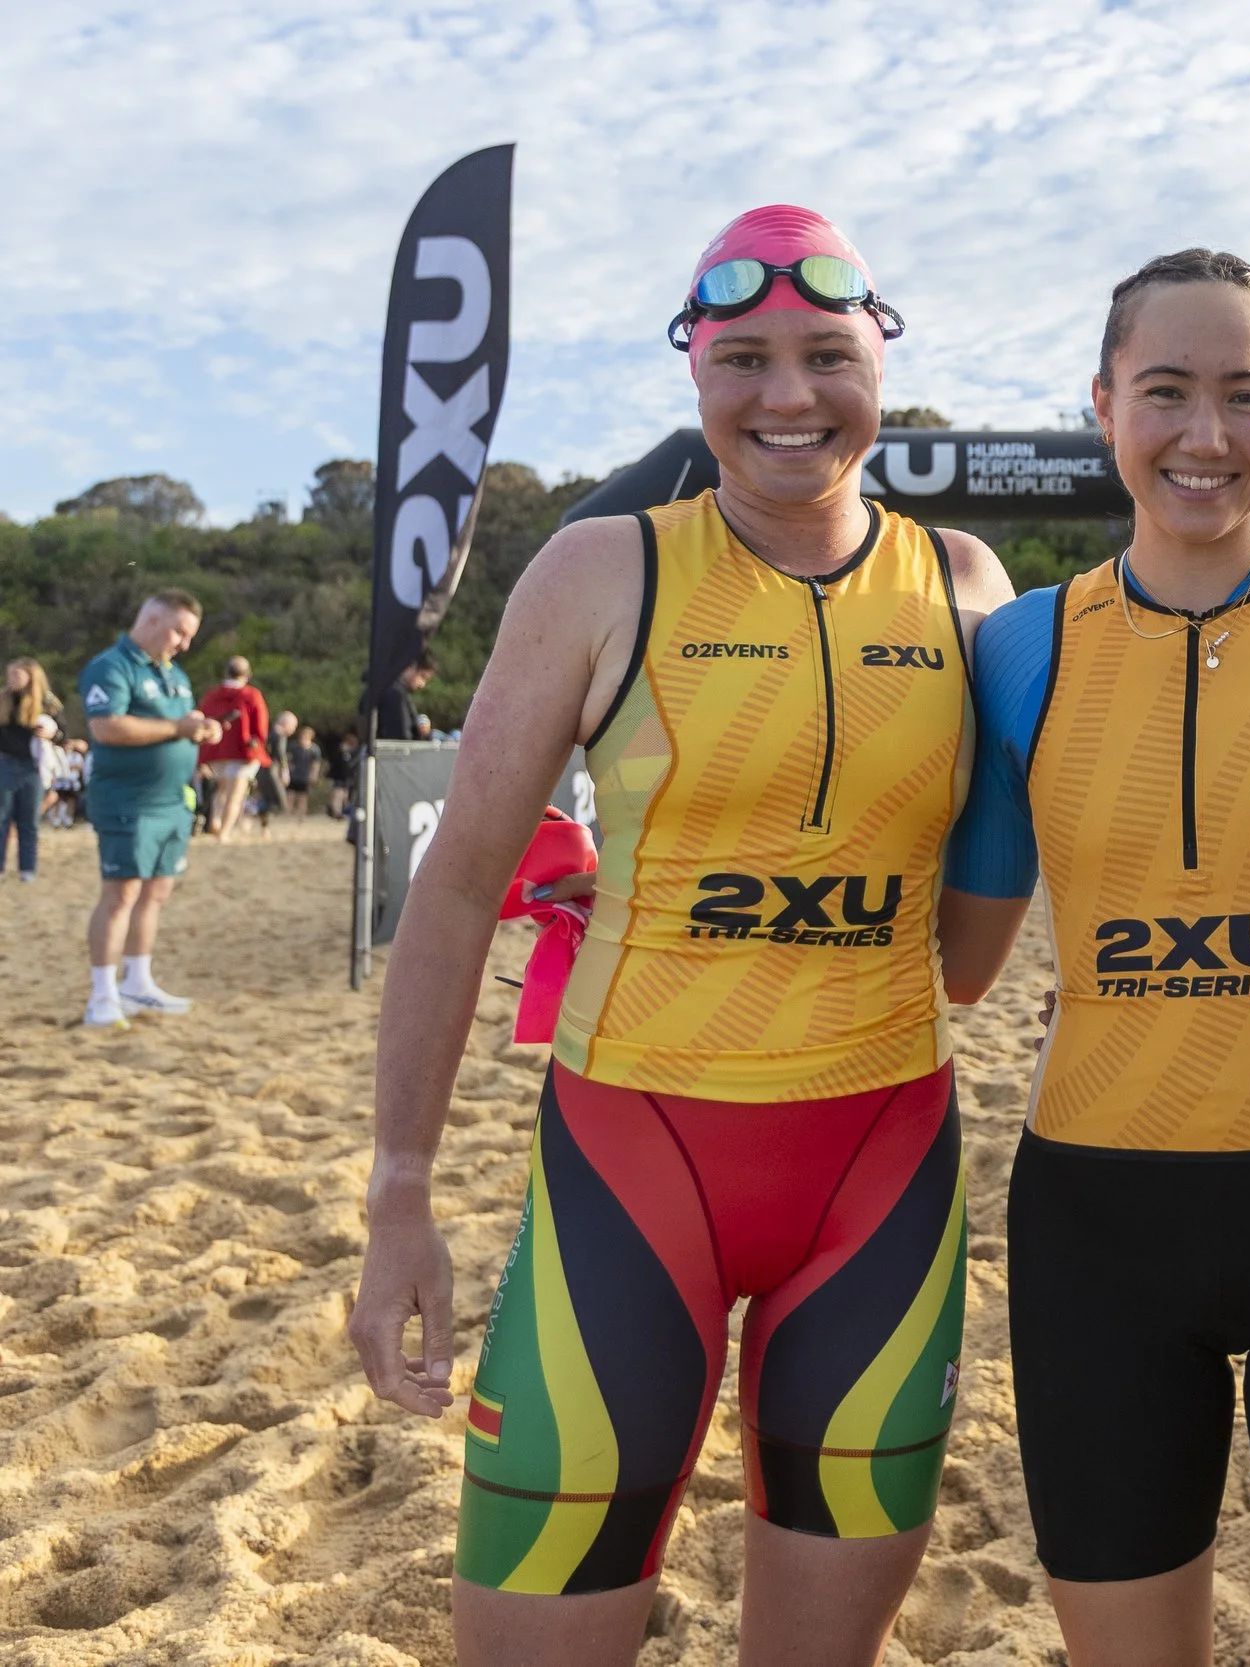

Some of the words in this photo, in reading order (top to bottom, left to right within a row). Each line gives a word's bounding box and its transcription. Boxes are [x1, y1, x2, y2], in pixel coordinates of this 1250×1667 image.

[966, 443, 1036, 457] HUMAN
[1071, 598, 1116, 623] O2EVENTS
[681, 643, 790, 660] O2EVENTS
[860, 644, 945, 671] 2XU
[690, 872, 904, 928] 2XU
[685, 924, 894, 947] TRI-SERIES
[483, 1198, 533, 1367] ZIMBABWE
